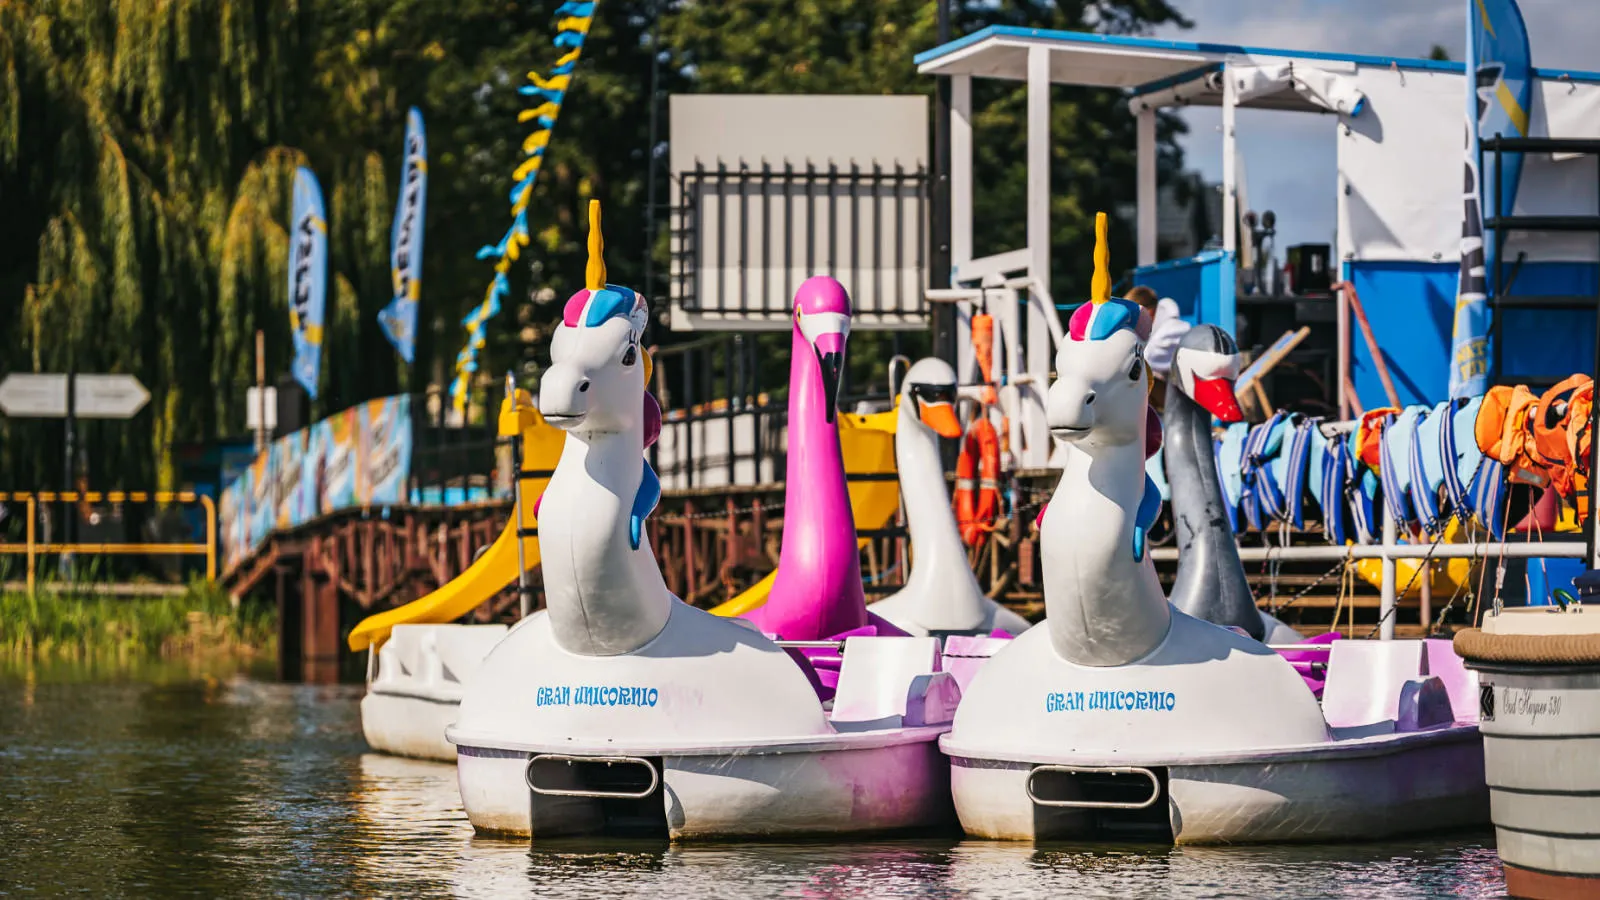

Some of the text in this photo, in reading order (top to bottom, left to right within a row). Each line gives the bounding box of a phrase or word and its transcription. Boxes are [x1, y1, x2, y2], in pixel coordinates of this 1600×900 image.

[537, 686, 658, 707] GRAN UNICORNIO
[1046, 690, 1176, 712] GRAN UNICORNIO
